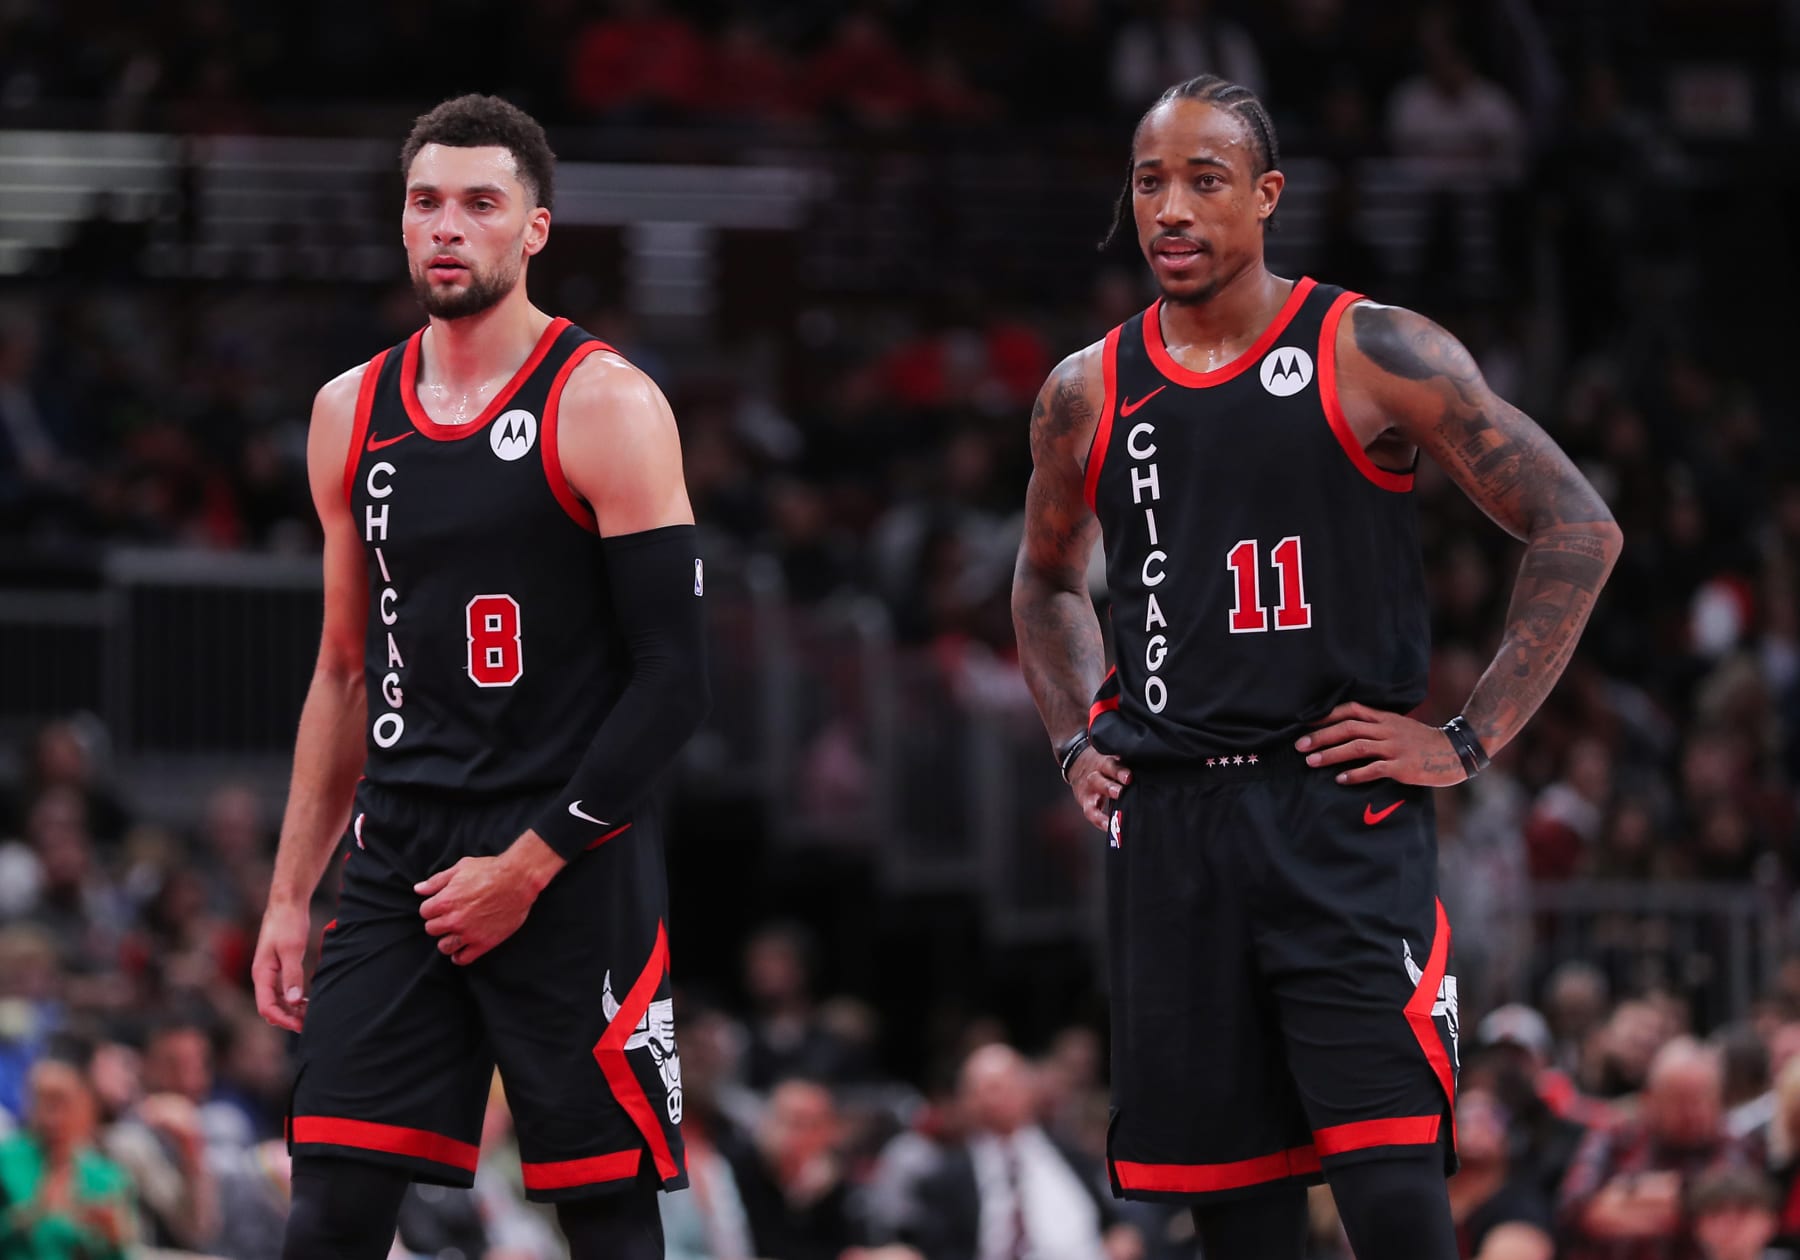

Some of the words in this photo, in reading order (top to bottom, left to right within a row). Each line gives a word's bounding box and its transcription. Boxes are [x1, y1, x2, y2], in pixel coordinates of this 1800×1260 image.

[365, 461, 405, 749] CHICAGO
[465, 594, 523, 688] 8
[1126, 422, 1169, 714] CHICAGO
[1226, 535, 1312, 634] 11
